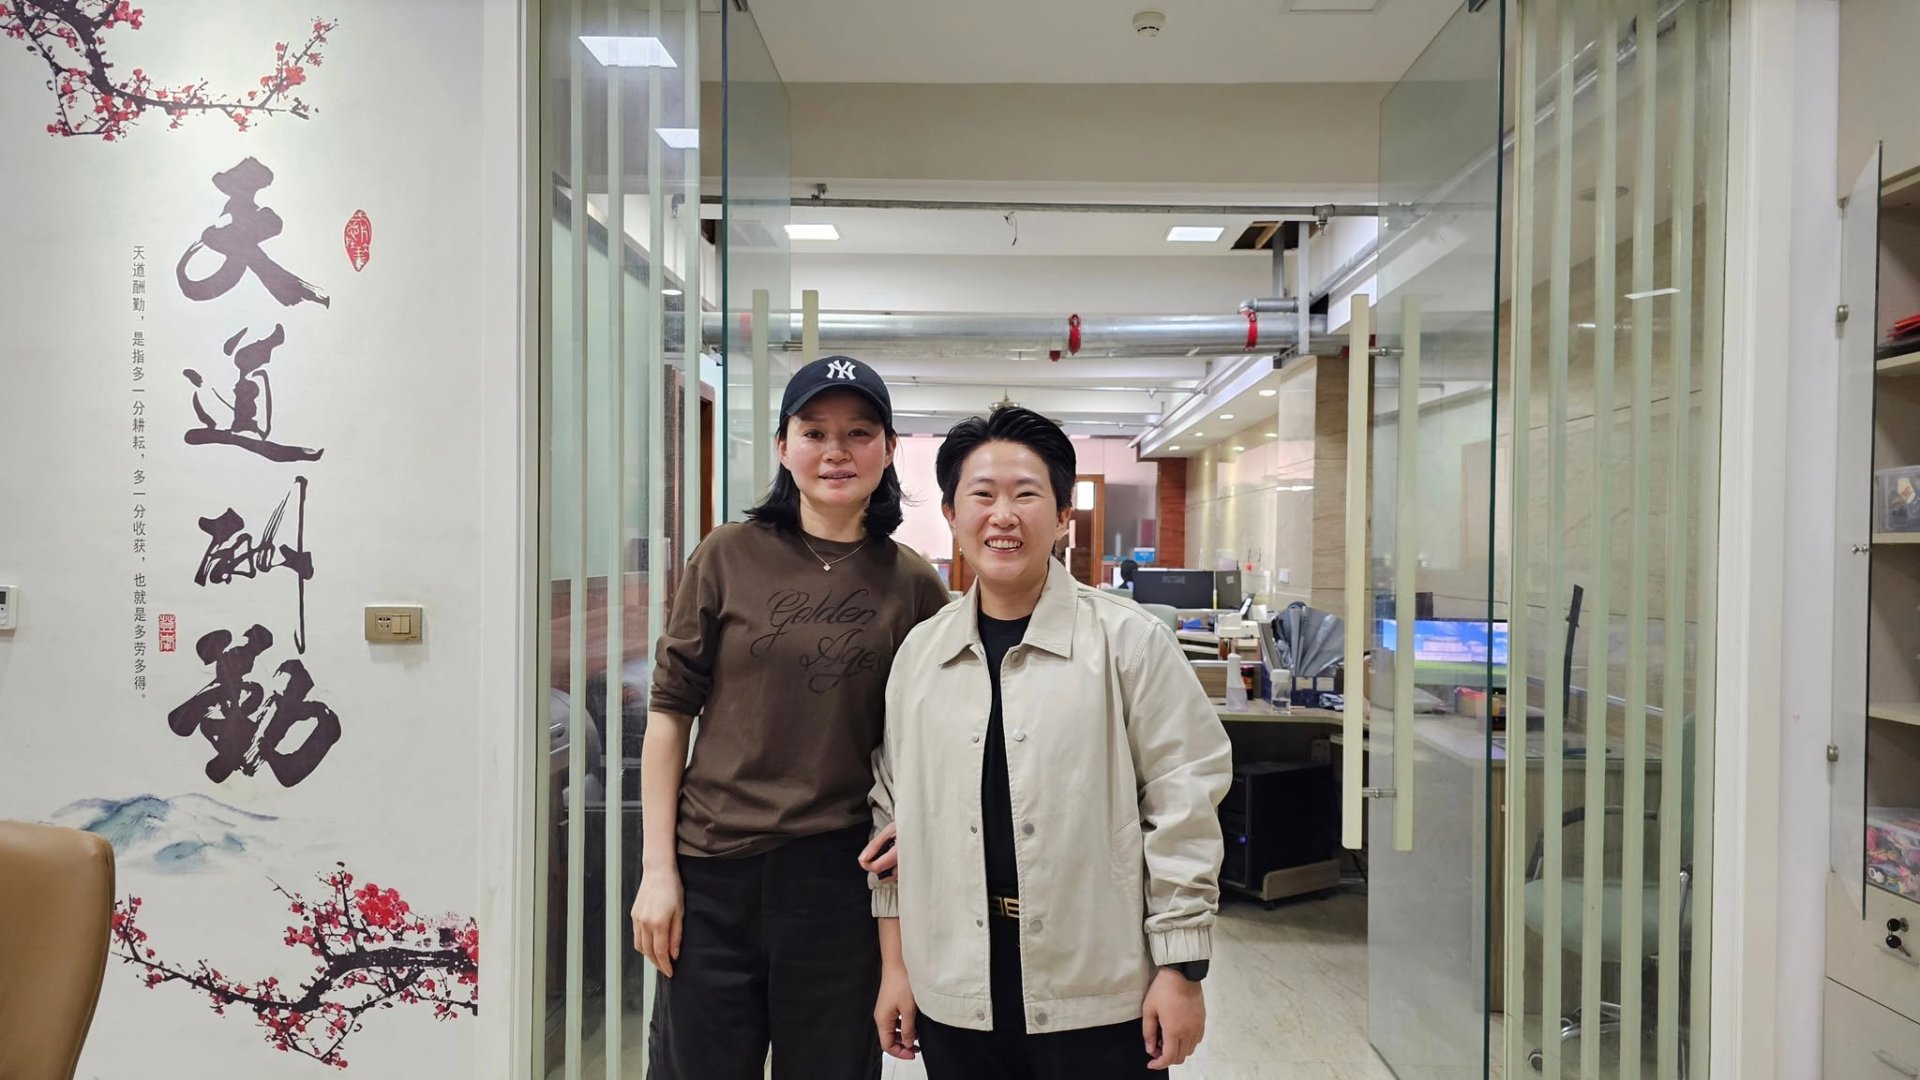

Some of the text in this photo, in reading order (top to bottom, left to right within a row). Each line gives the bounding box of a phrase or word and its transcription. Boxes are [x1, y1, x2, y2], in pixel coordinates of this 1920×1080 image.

[826, 359, 857, 380] NY
[168, 156, 341, 787] 天道酬勤
[750, 586, 877, 658] Golden
